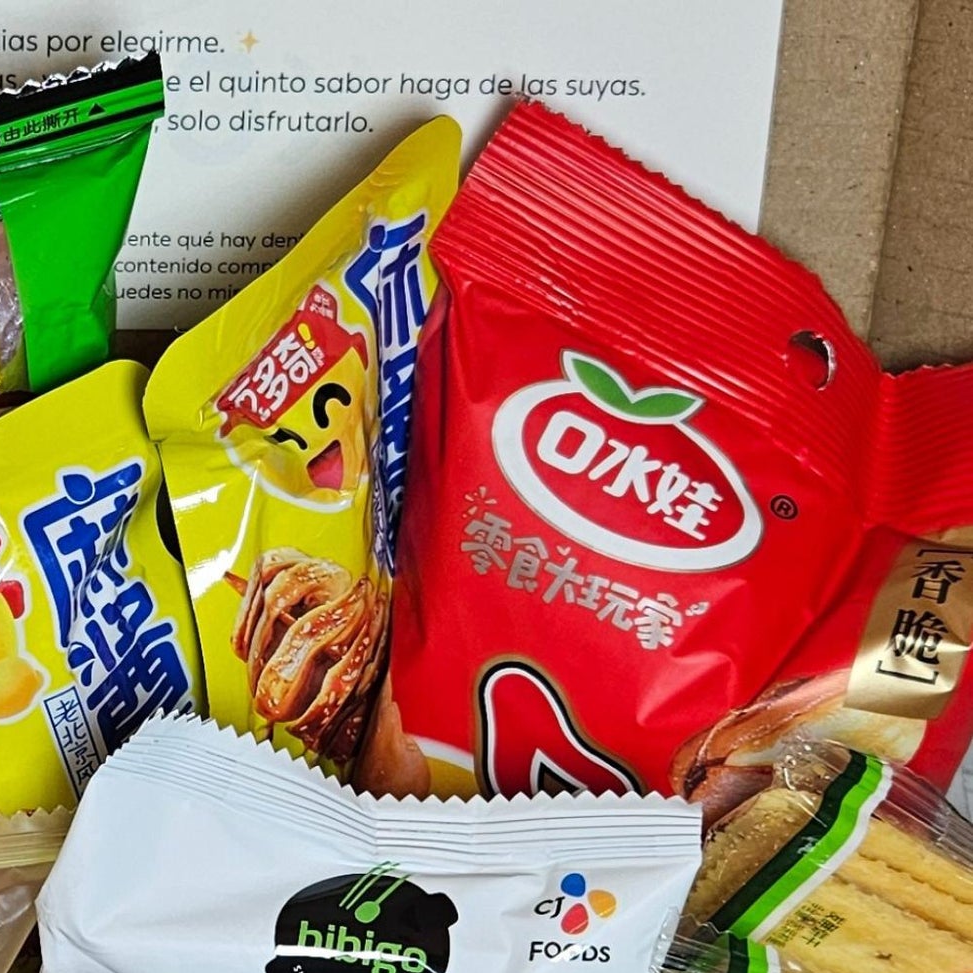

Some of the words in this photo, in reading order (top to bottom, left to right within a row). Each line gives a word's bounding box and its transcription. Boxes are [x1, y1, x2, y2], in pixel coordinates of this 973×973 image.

[46, 33, 93, 58] por
[100, 30, 225, 53] elegirme.
[189, 71, 211, 92] el
[219, 70, 306, 97] quinto
[314, 72, 392, 94] sabor
[400, 73, 470, 100] haga
[479, 74, 513, 95] de
[521, 74, 557, 95] las
[565, 77, 646, 101] suyas.
[167, 110, 221, 132] solo
[229, 110, 374, 132] disfrutarlo.
[124, 231, 172, 247] ente
[177, 231, 215, 250] qué
[220, 231, 257, 251] hay
[114, 258, 212, 274] contenido
[177, 288, 202, 300] no
[536, 410, 724, 542] 口水娃
[461, 510, 683, 650] 零食大玩家
[534, 895, 565, 919] CJ
[528, 940, 611, 963] FOODS
